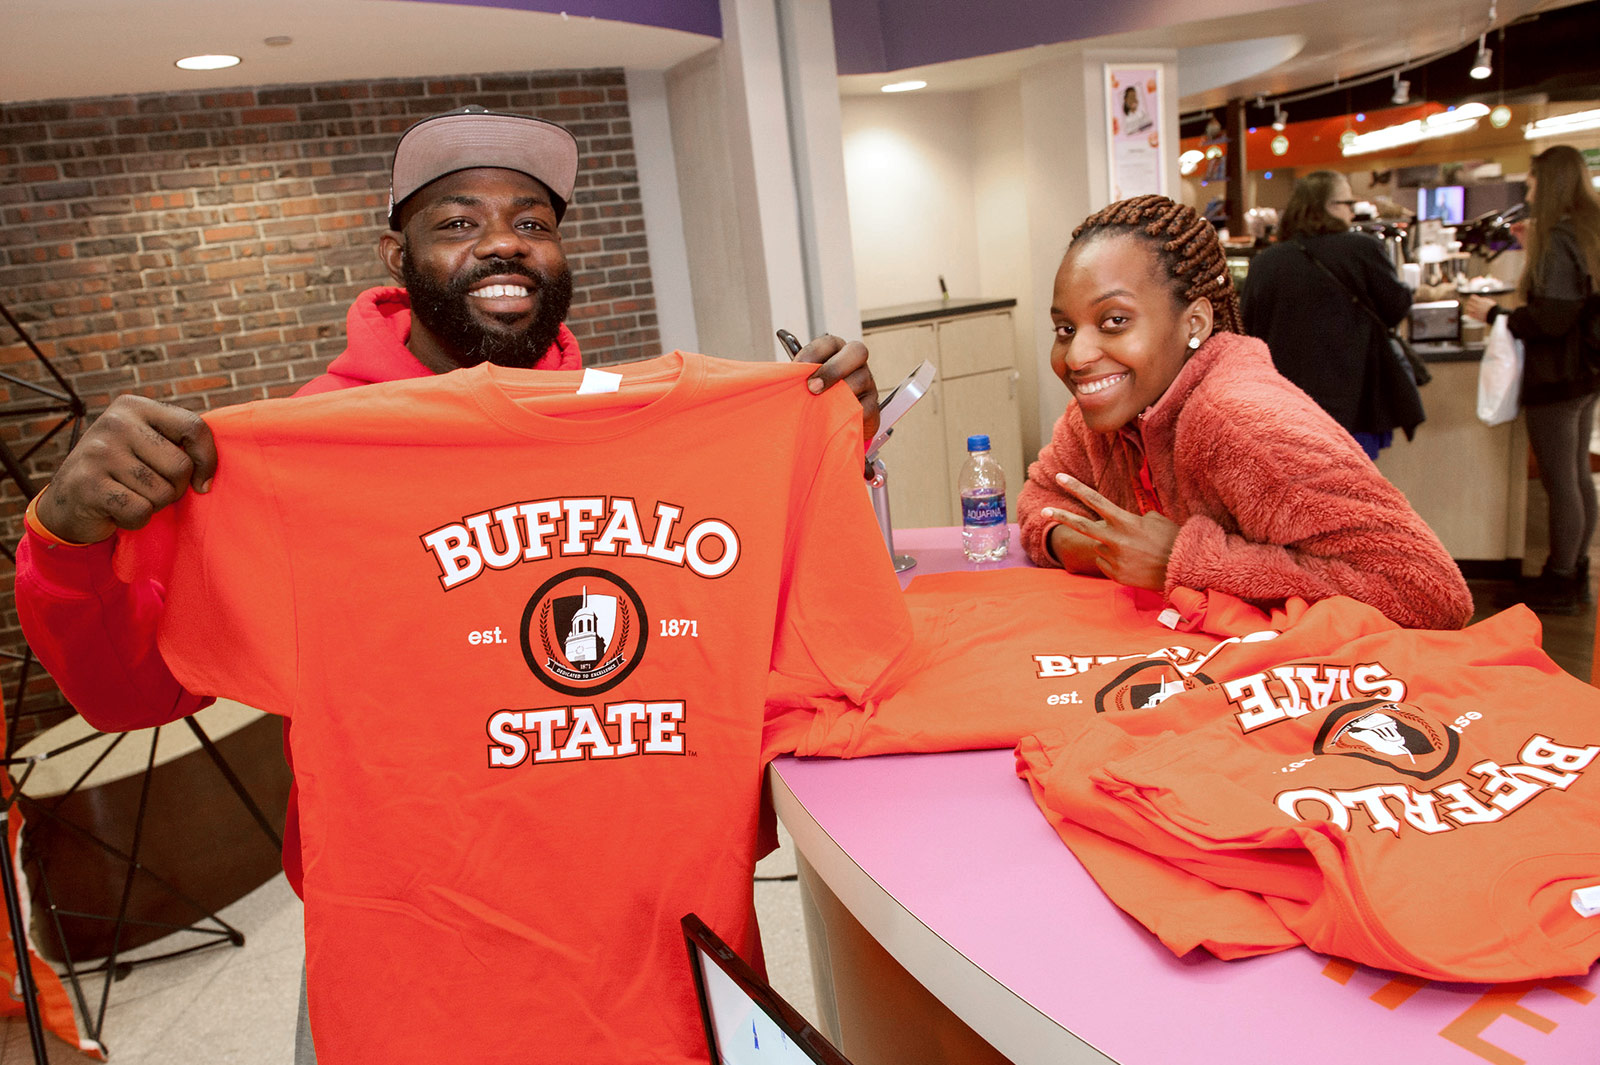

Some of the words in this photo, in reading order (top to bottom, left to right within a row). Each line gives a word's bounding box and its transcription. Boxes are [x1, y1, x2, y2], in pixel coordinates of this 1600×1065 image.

[967, 508, 1003, 520] AQUAFINA
[419, 496, 741, 592] BUFFALO
[468, 627, 507, 645] est.
[660, 619, 699, 638] 1871
[556, 667, 581, 679] DEDICATED
[1047, 690, 1083, 706] est.
[487, 700, 686, 768] STATE
